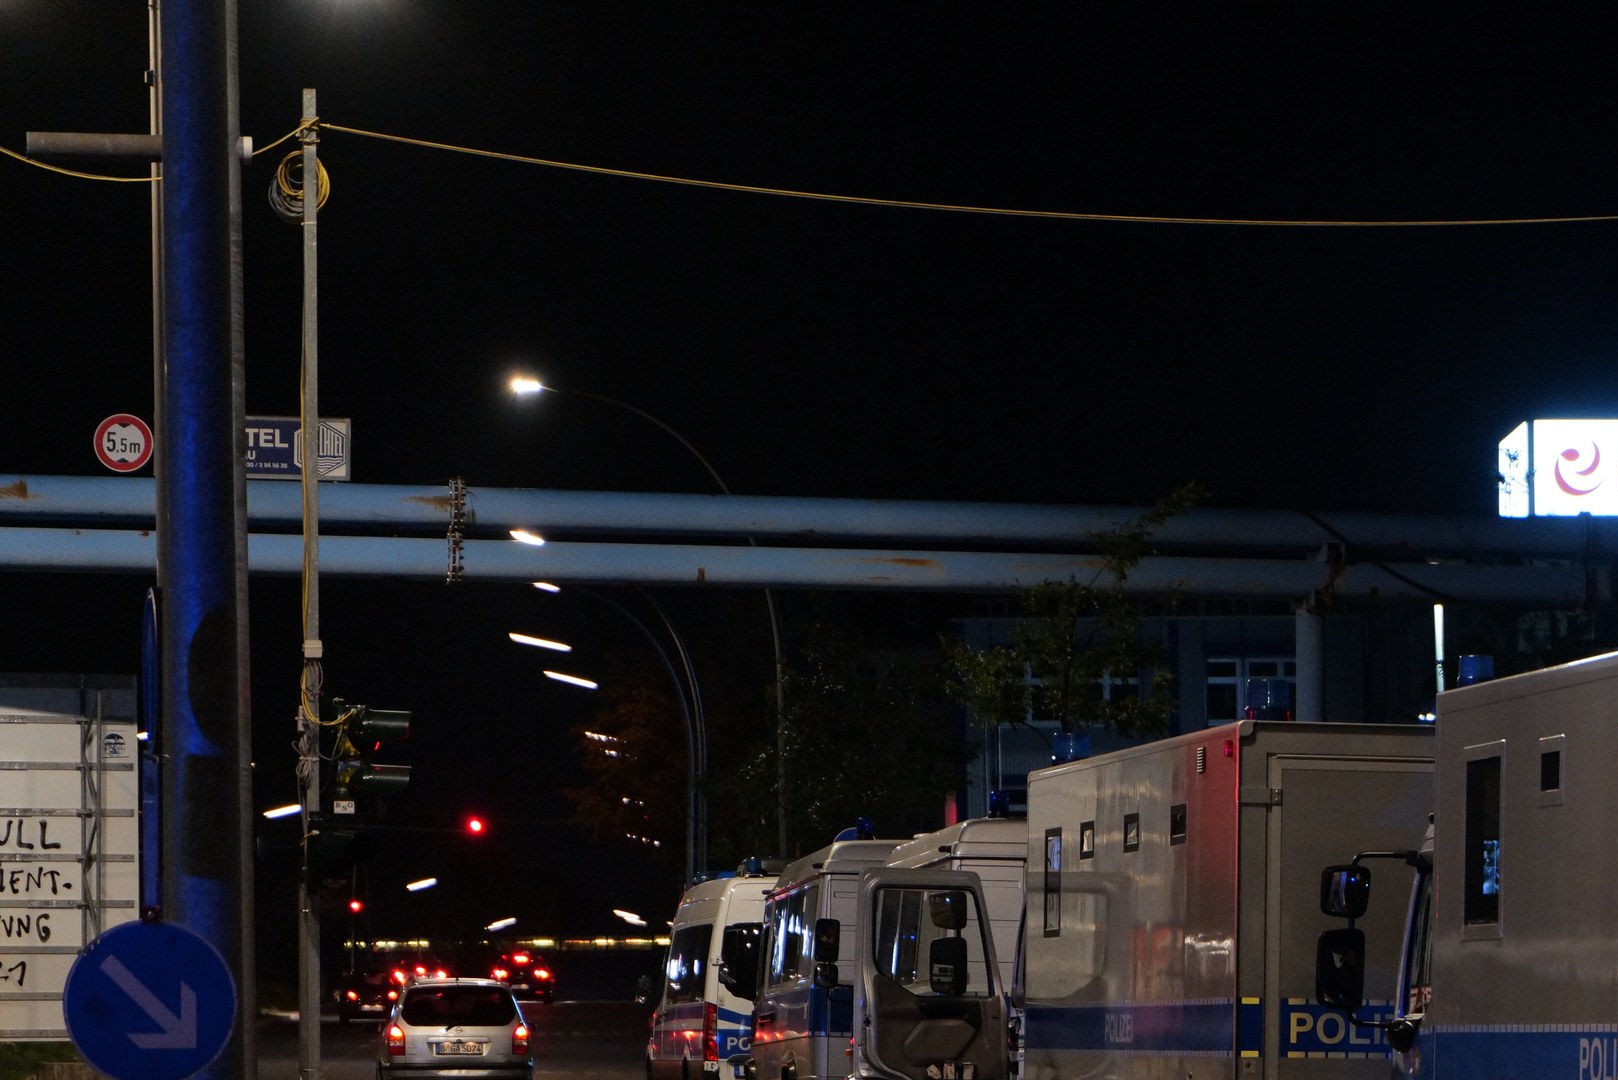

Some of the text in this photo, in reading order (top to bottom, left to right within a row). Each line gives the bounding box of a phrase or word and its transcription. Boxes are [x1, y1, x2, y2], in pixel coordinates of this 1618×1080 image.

[245, 428, 289, 448] TEL
[1104, 1014, 1133, 1043] POLIZEI
[726, 1036, 752, 1051] PO
